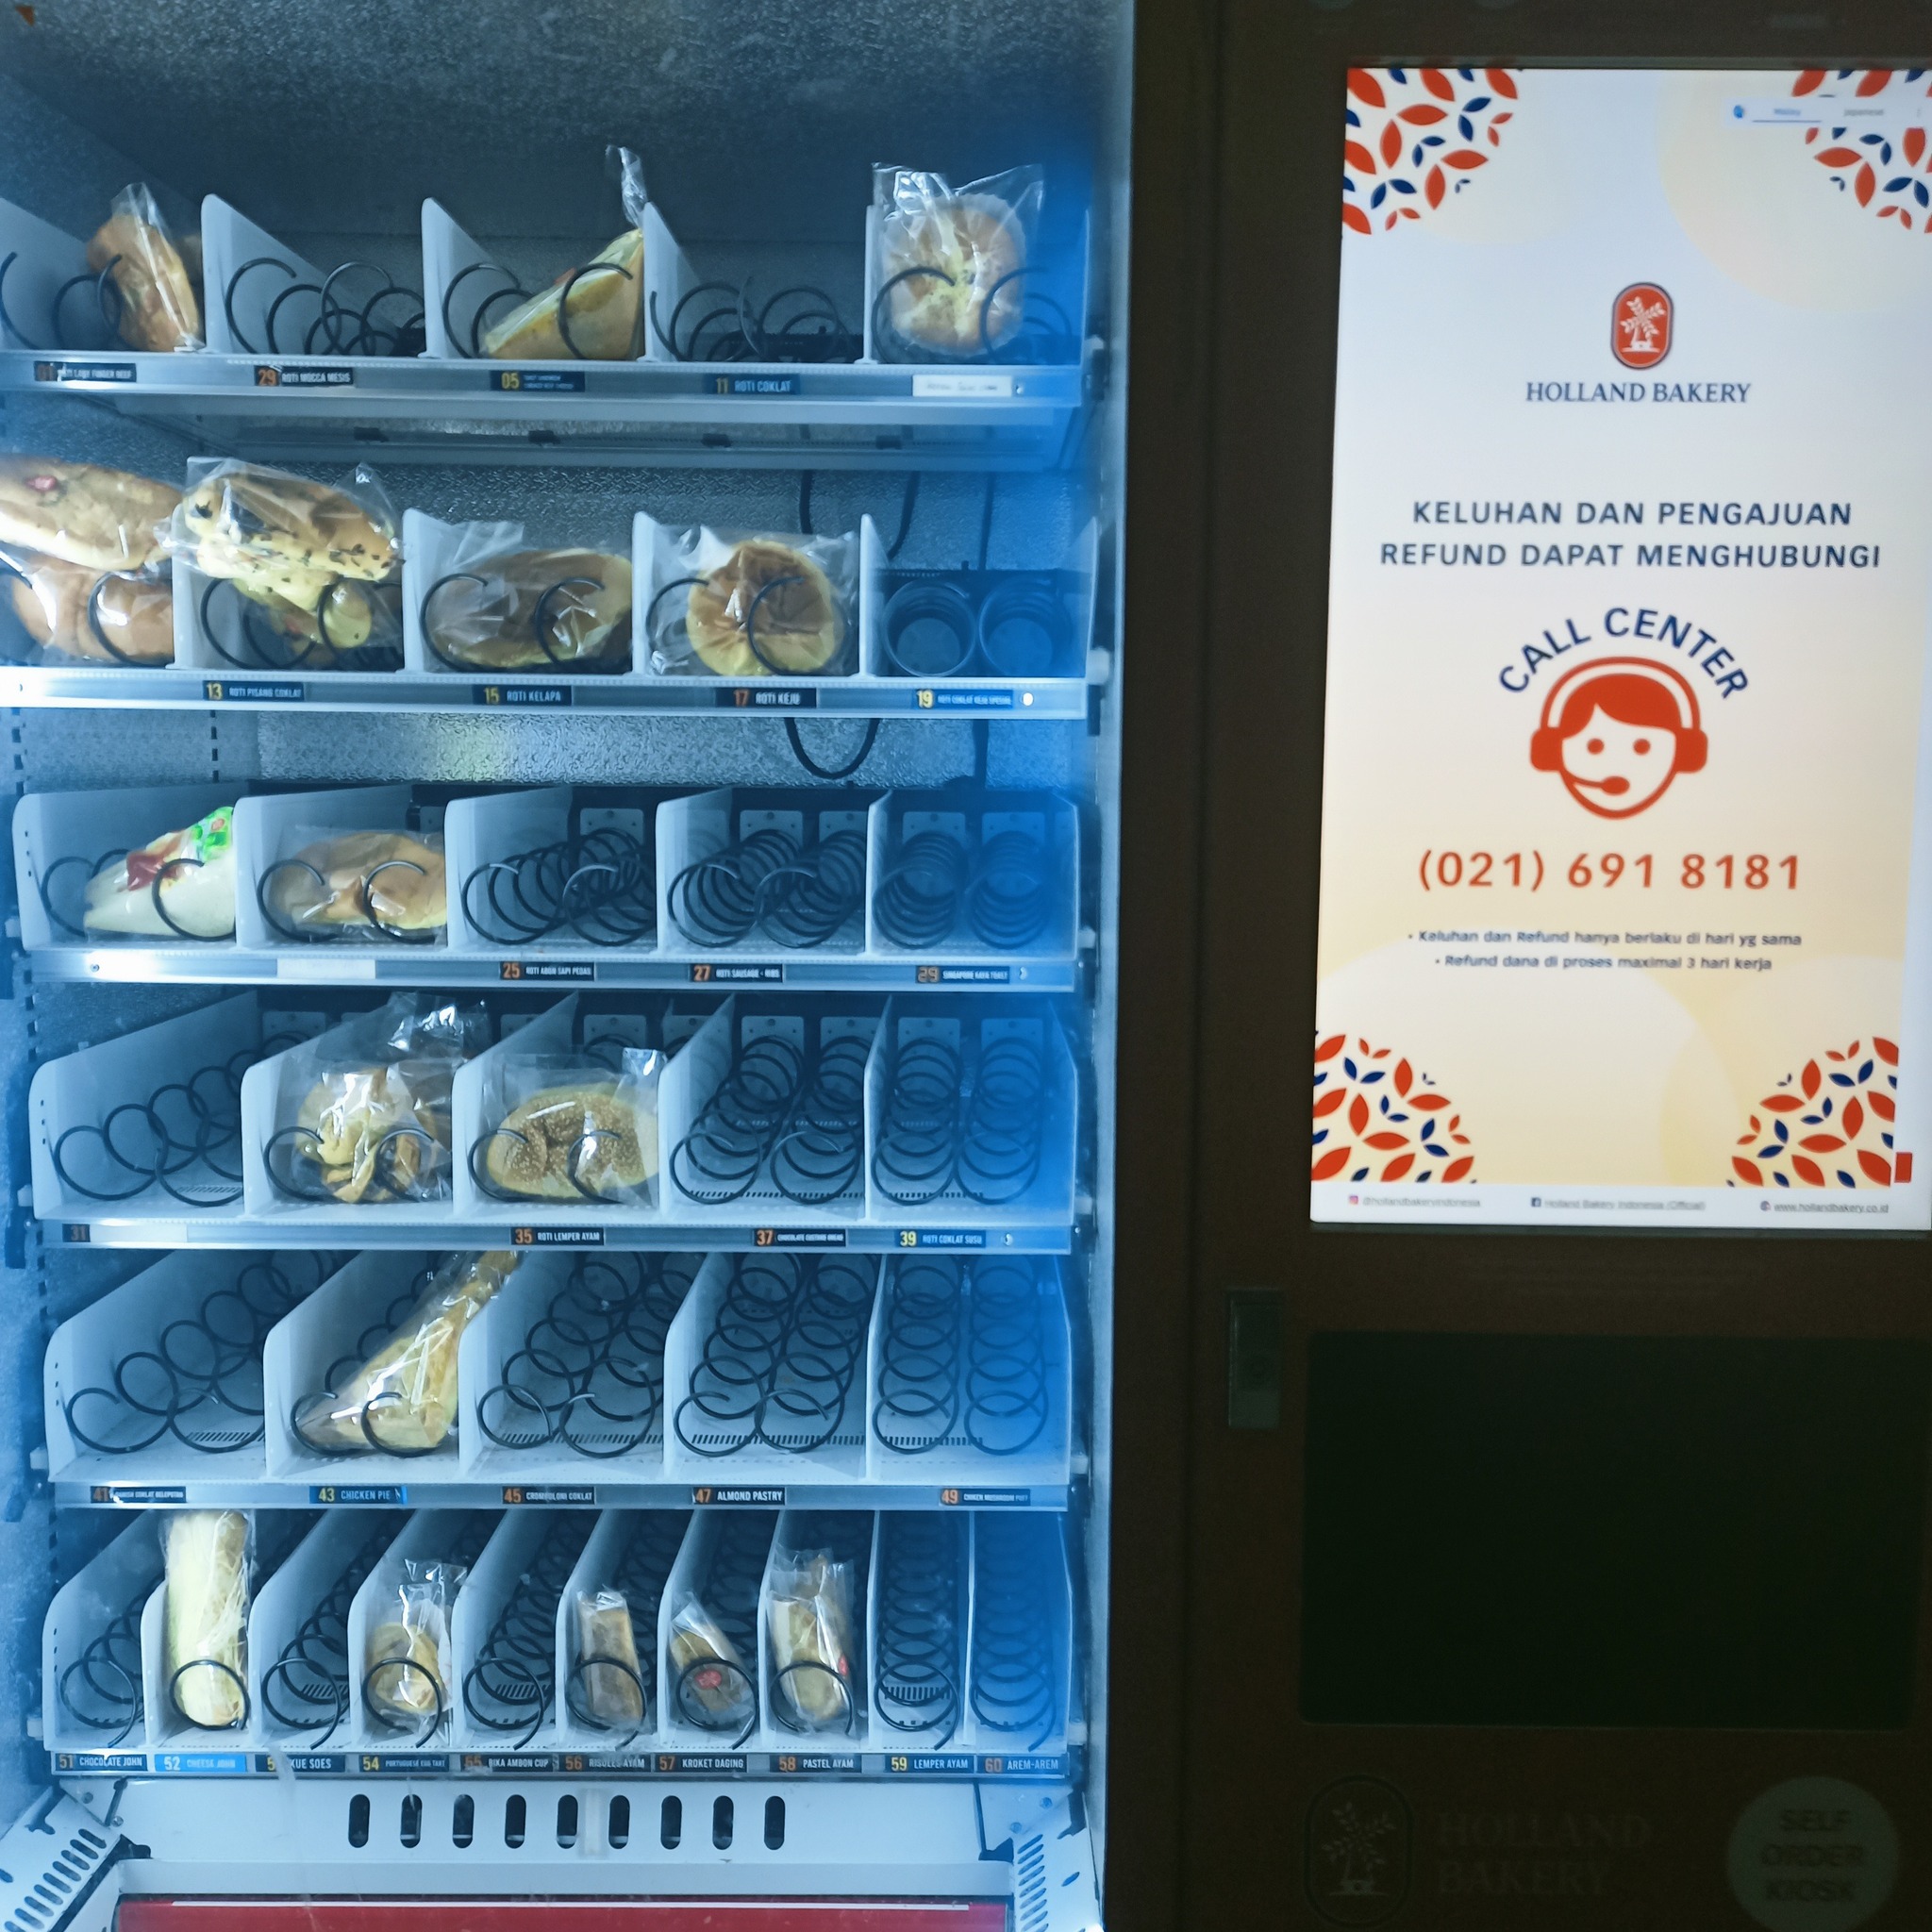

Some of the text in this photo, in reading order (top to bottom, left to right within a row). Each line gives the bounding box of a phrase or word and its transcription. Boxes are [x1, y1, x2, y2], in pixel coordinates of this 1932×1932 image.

[501, 373, 520, 389] 05
[716, 377, 791, 393] 11 ROTI COKLAT
[1525, 382, 1752, 404] HOLLAND BAKERY
[1413, 501, 1852, 525] KELUHAN DAN PENGAJUAN
[1380, 543, 1881, 568] REFUND DAPAT MENGHUBUNGI
[1498, 607, 1750, 699] CALL CENTER
[207, 683, 223, 701] 13
[228, 688, 245, 697] ROTI
[484, 687, 560, 704] 15 ROTI KELAPA
[734, 689, 800, 707] 17 ROTI KEJU
[917, 690, 933, 708] 19
[1419, 849, 1799, 892] (021) 691 8181
[1419, 931, 1802, 948] Keluhan dan Refund hanya berlaku di hari yg sama
[503, 962, 521, 979] 25
[1444, 956, 1772, 972] Refund dana di proses maximal 3 hari kerja
[694, 965, 711, 981] 27
[515, 1229, 600, 1244] 35 ROTI LEMPER AYAM
[757, 1229, 774, 1245] 37
[900, 1231, 982, 1246] 39 ROTI COKLAT SUSU
[319, 1488, 391, 1502] 43 CHICKEN PIE
[505, 1489, 522, 1503] 45
[695, 1489, 783, 1503] 47 ALMOND PASTRY
[941, 1490, 958, 1505] 49
[59, 1755, 142, 1769] 51 CHOCOLATE JOHN
[164, 1757, 181, 1771] 52
[187, 1758, 214, 1768] CHEESE
[291, 1758, 308, 1769] KUE
[308, 1758, 332, 1769] SOES
[362, 1756, 380, 1771] 54
[488, 1758, 506, 1768] BIKA
[507, 1758, 533, 1768] AMBON
[534, 1758, 549, 1768] CUP
[565, 1756, 583, 1771] 56
[623, 1758, 645, 1769] AYAM
[659, 1756, 743, 1771] 57 KROKET DAGING
[778, 1757, 855, 1772] 58 PASTEL AYAM
[891, 1757, 969, 1772] 59 LEMPER AYAM
[984, 1757, 1058, 1774] 60 AREM-AREM
[1780, 1808, 1849, 1831] SELF
[1438, 1811, 1652, 1848] HOLLAND
[1760, 1844, 1864, 1868] ORDER
[1439, 1860, 1610, 1896] BAKERY
[1764, 1879, 1856, 1903] KIOSK
